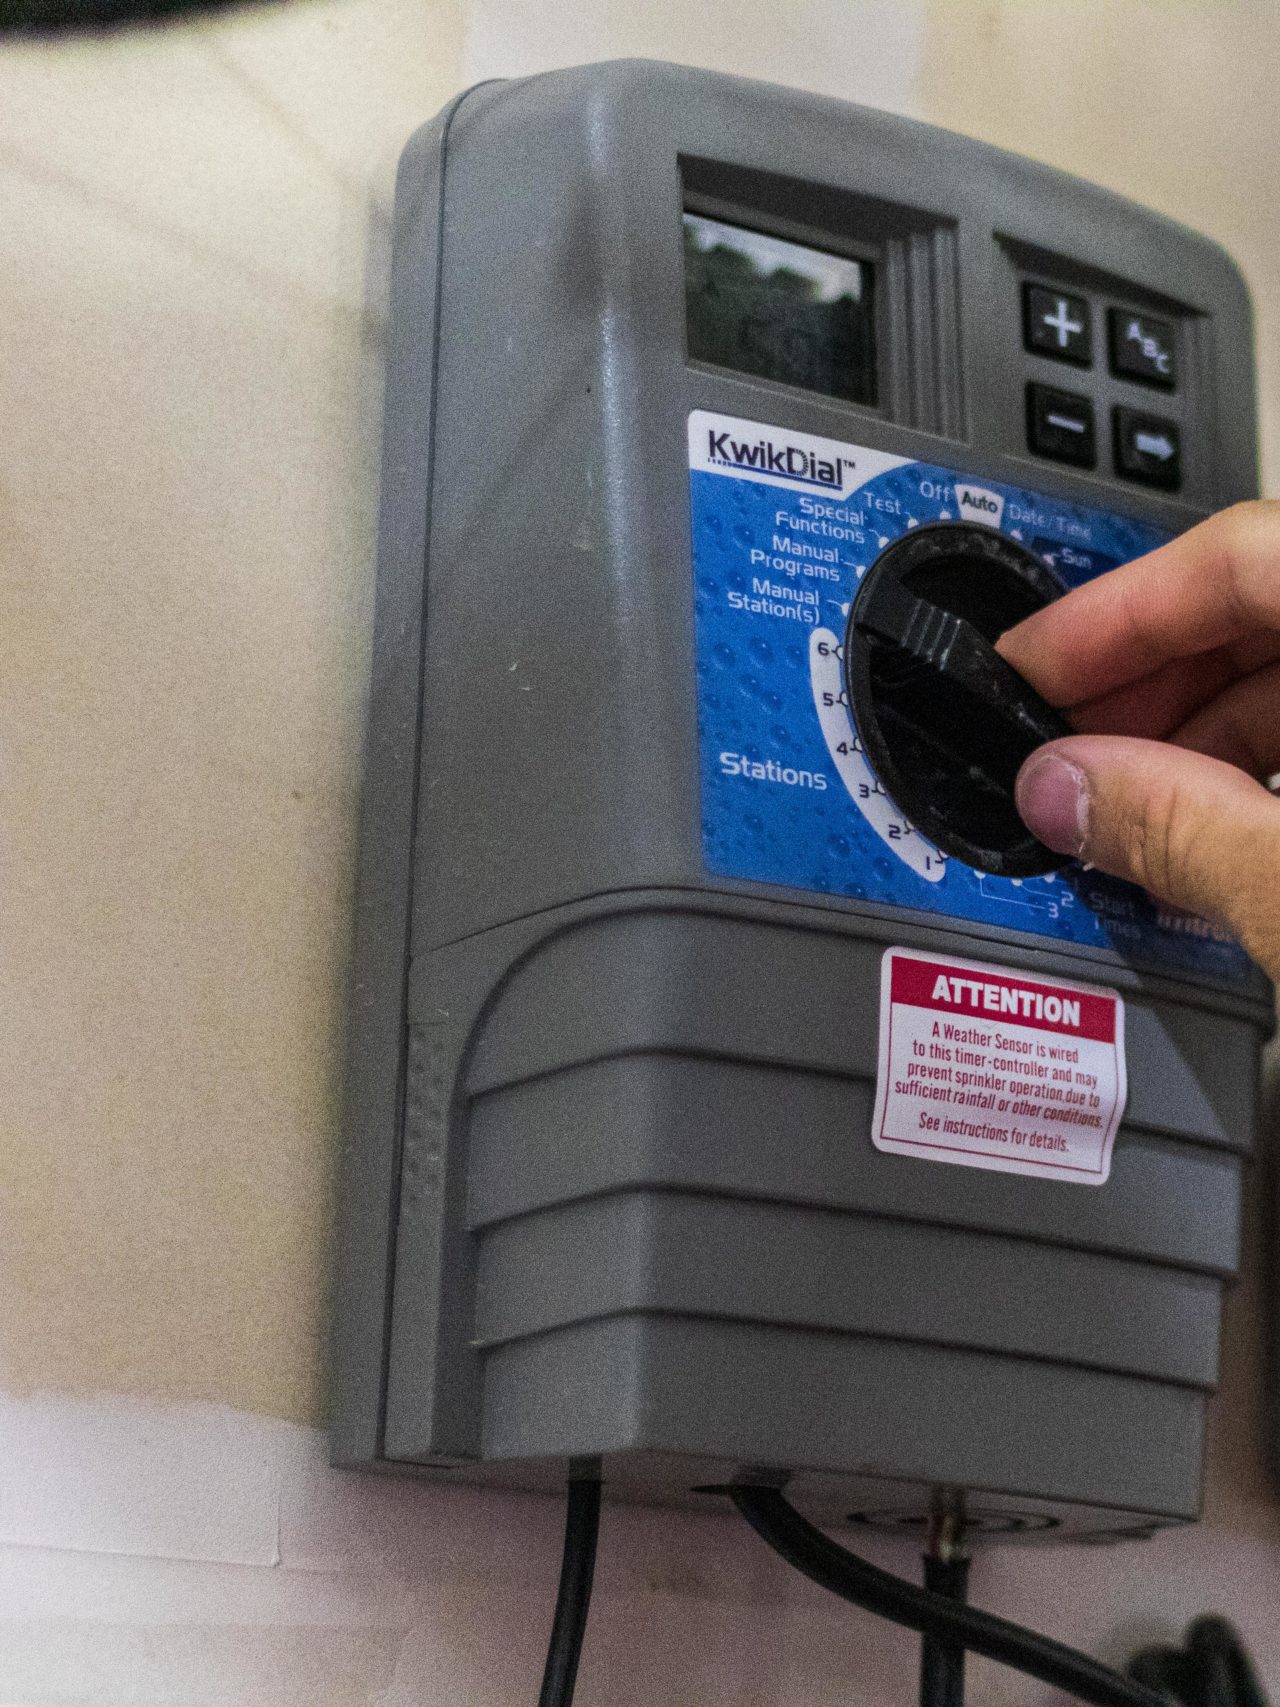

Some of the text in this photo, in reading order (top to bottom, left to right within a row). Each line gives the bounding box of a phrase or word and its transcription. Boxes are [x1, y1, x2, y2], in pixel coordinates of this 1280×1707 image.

[864, 491, 902, 515] Test
[918, 480, 952, 503] Off
[961, 491, 999, 515] Auto
[799, 497, 865, 527] Special
[775, 511, 866, 545] Functions
[772, 534, 841, 564] Manual
[1060, 546, 1093, 570] Sun
[751, 549, 841, 583] Programs
[752, 577, 820, 606] Manual
[727, 591, 820, 625] Station(s)
[818, 642, 829, 656] 6
[823, 692, 834, 707] 5
[836, 742, 848, 756] 4
[719, 751, 828, 791] Stations
[859, 783, 870, 798] 3
[888, 824, 901, 840] 2
[1048, 902, 1059, 919] 3
[1061, 891, 1074, 908] 2
[931, 974, 1081, 1027] ATTENTION
[932, 1021, 1079, 1064] A Weather Sensor is wired
[912, 1040, 926, 1057] to
[929, 1043, 952, 1061] this
[1052, 1067, 1072, 1083] and
[1075, 1072, 1098, 1089] may
[907, 1063, 1101, 1108] prevent sprinkler operation due to
[895, 1080, 1104, 1129] sufficient rainfall or other conditions.
[919, 1111, 1071, 1153] See instructions for details.
